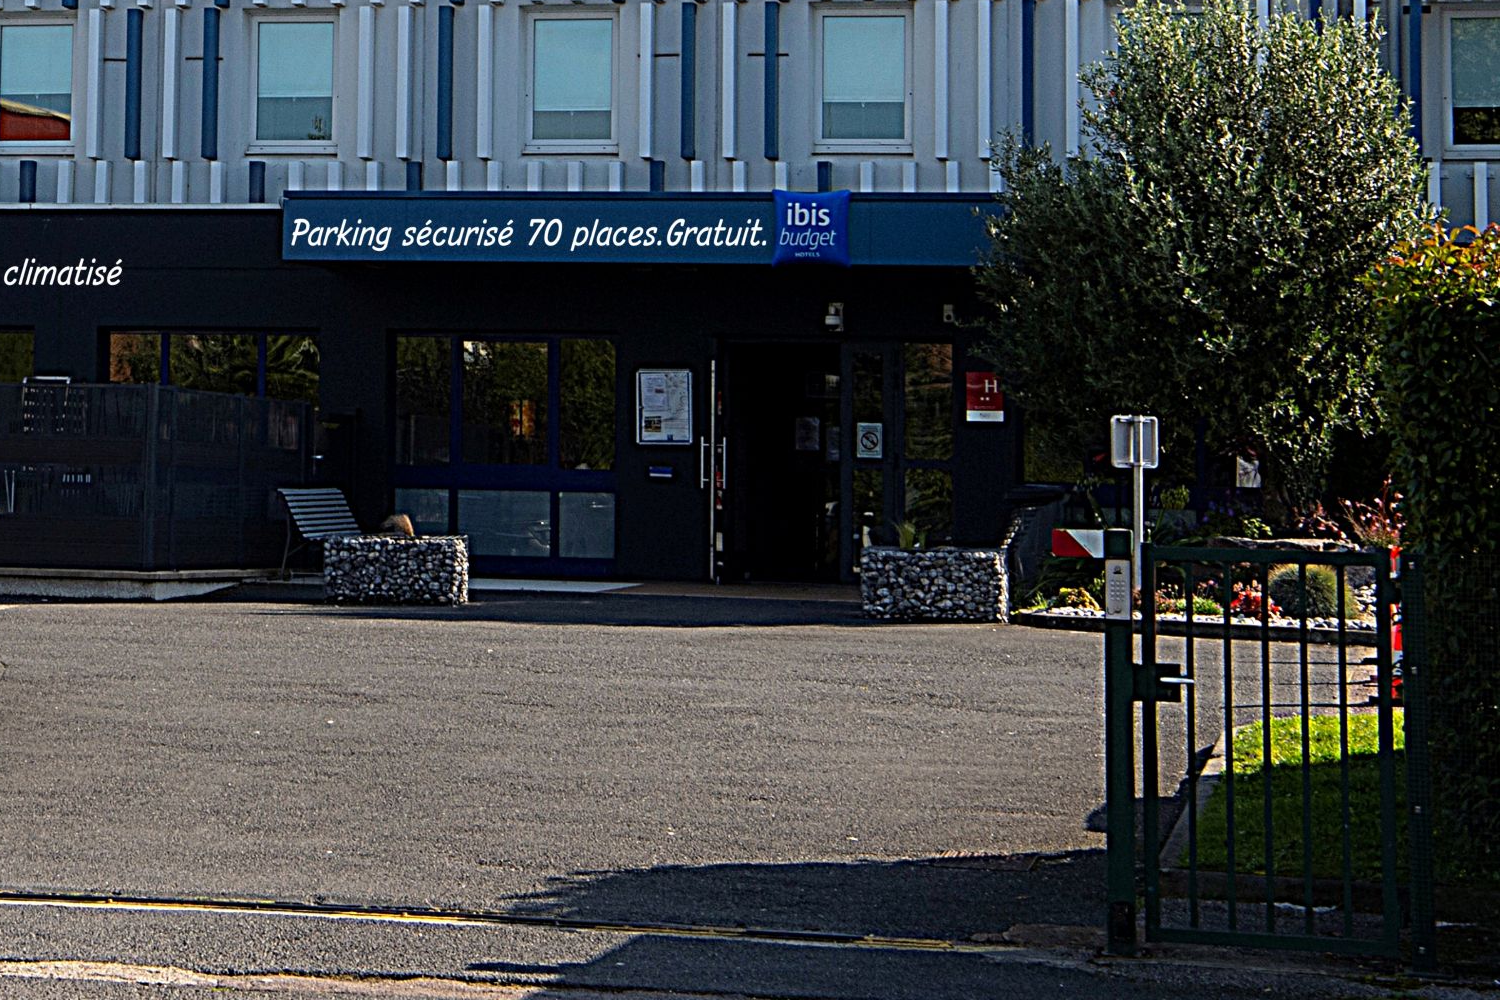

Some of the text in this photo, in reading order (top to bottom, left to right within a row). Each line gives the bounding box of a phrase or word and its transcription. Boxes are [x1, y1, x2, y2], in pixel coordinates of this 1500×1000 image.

[787, 202, 831, 226] ibis
[291, 218, 392, 252] Parking
[401, 218, 513, 247] sécurisé
[528, 218, 562, 247] 70
[779, 227, 837, 250] budget
[3, 257, 123, 286] climatisé
[984, 378, 999, 394] H
